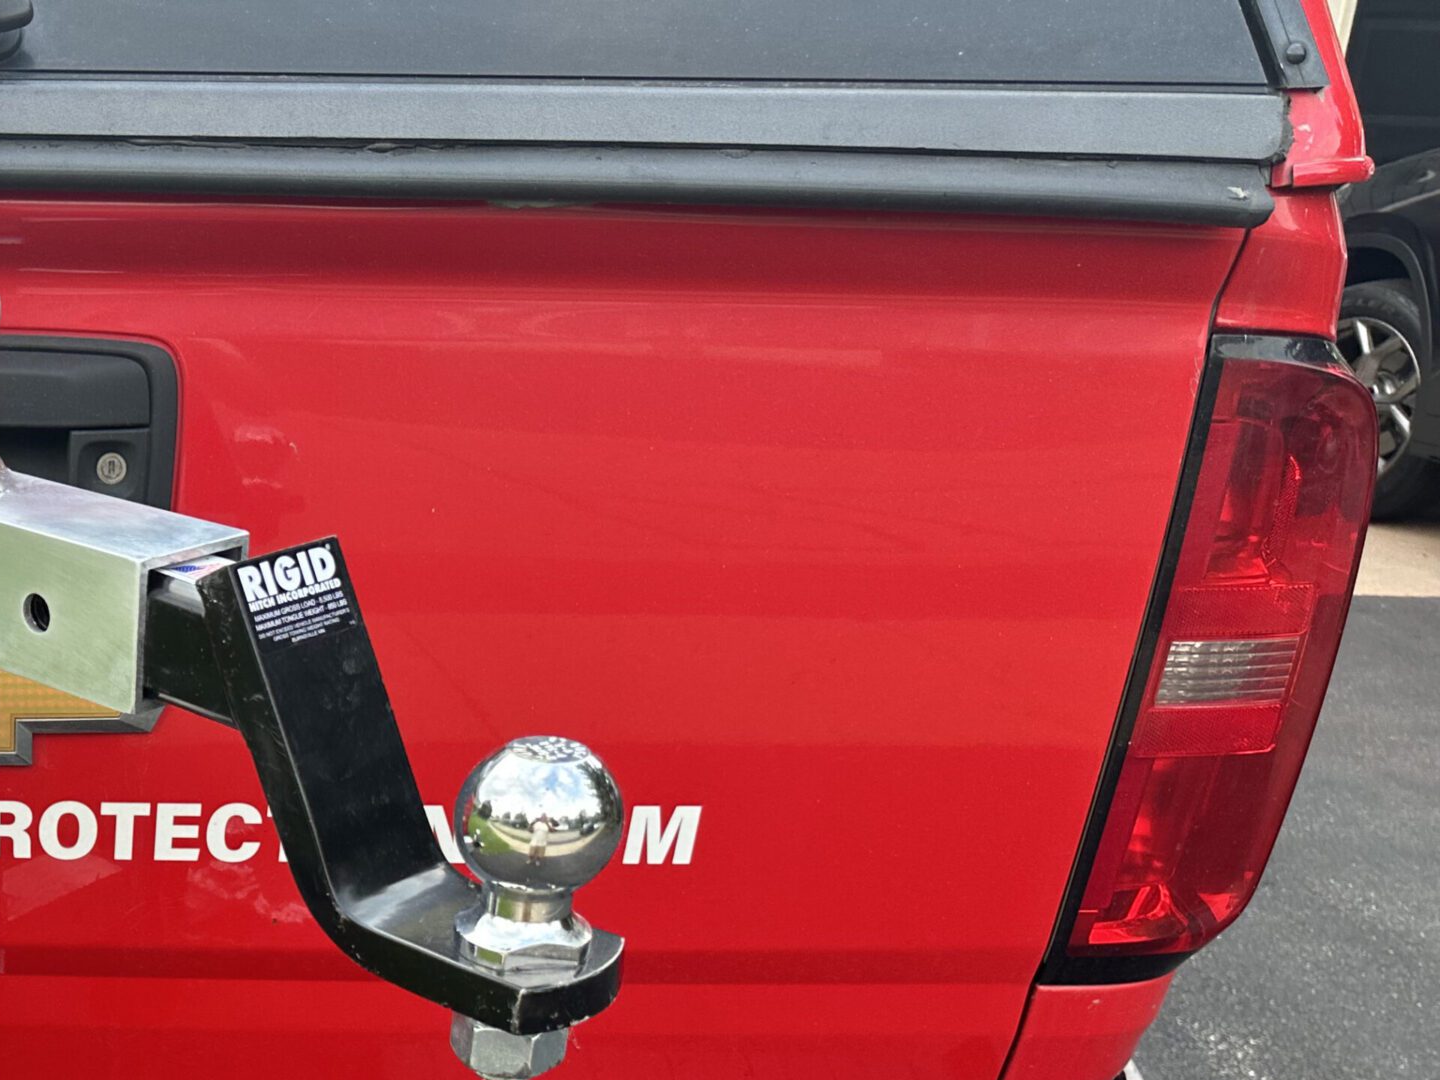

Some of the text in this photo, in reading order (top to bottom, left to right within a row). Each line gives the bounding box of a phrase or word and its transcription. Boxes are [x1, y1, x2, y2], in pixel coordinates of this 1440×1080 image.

[237, 547, 337, 603] RIGID
[248, 577, 342, 612] HITCH INCORPORATED
[254, 609, 282, 622] MAXIMUM
[301, 598, 317, 609] LOAD
[255, 618, 282, 632] MAXIMUM
[281, 611, 305, 624] TONGUE
[303, 605, 325, 618] WEIGHT
